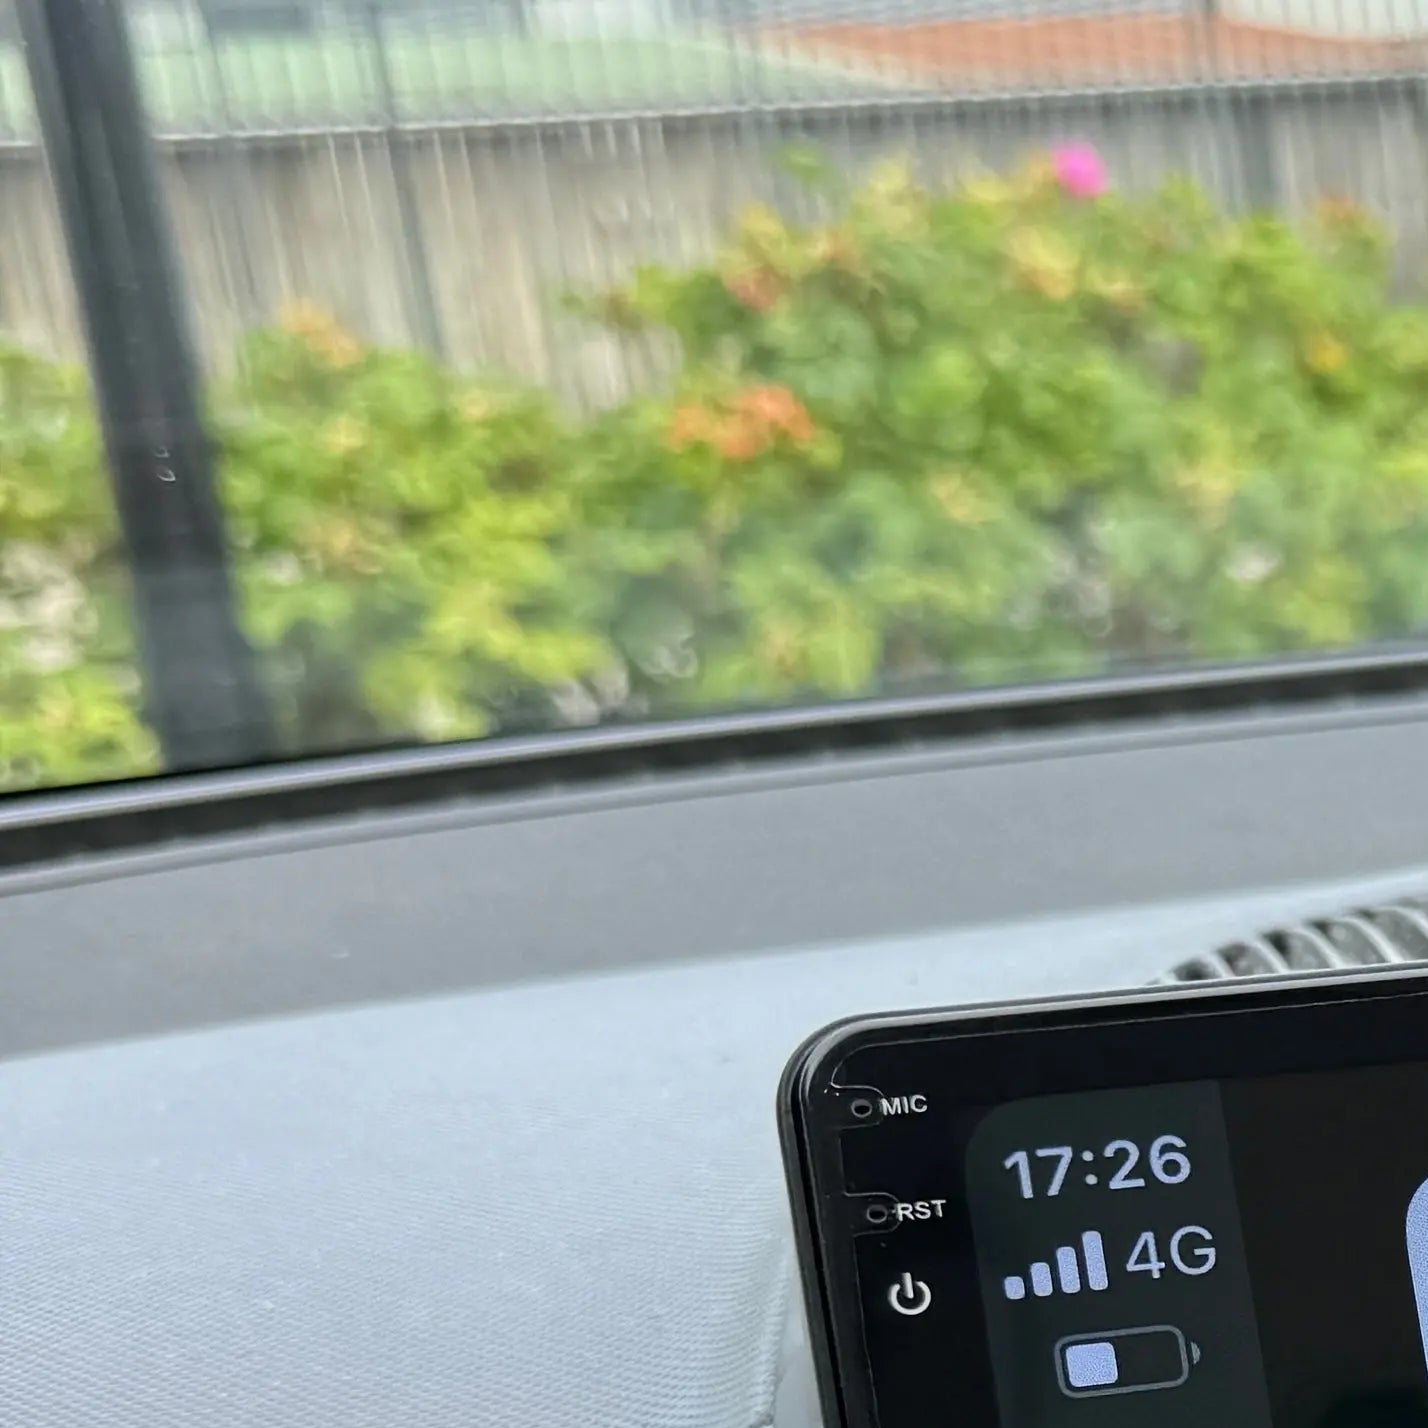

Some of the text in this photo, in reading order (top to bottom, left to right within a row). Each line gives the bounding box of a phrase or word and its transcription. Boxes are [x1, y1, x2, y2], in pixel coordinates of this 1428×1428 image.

[880, 1094, 928, 1116] MIC
[1003, 1133, 1192, 1200] 17:26
[895, 1198, 947, 1222] RST
[1125, 1225, 1217, 1279] 4G
